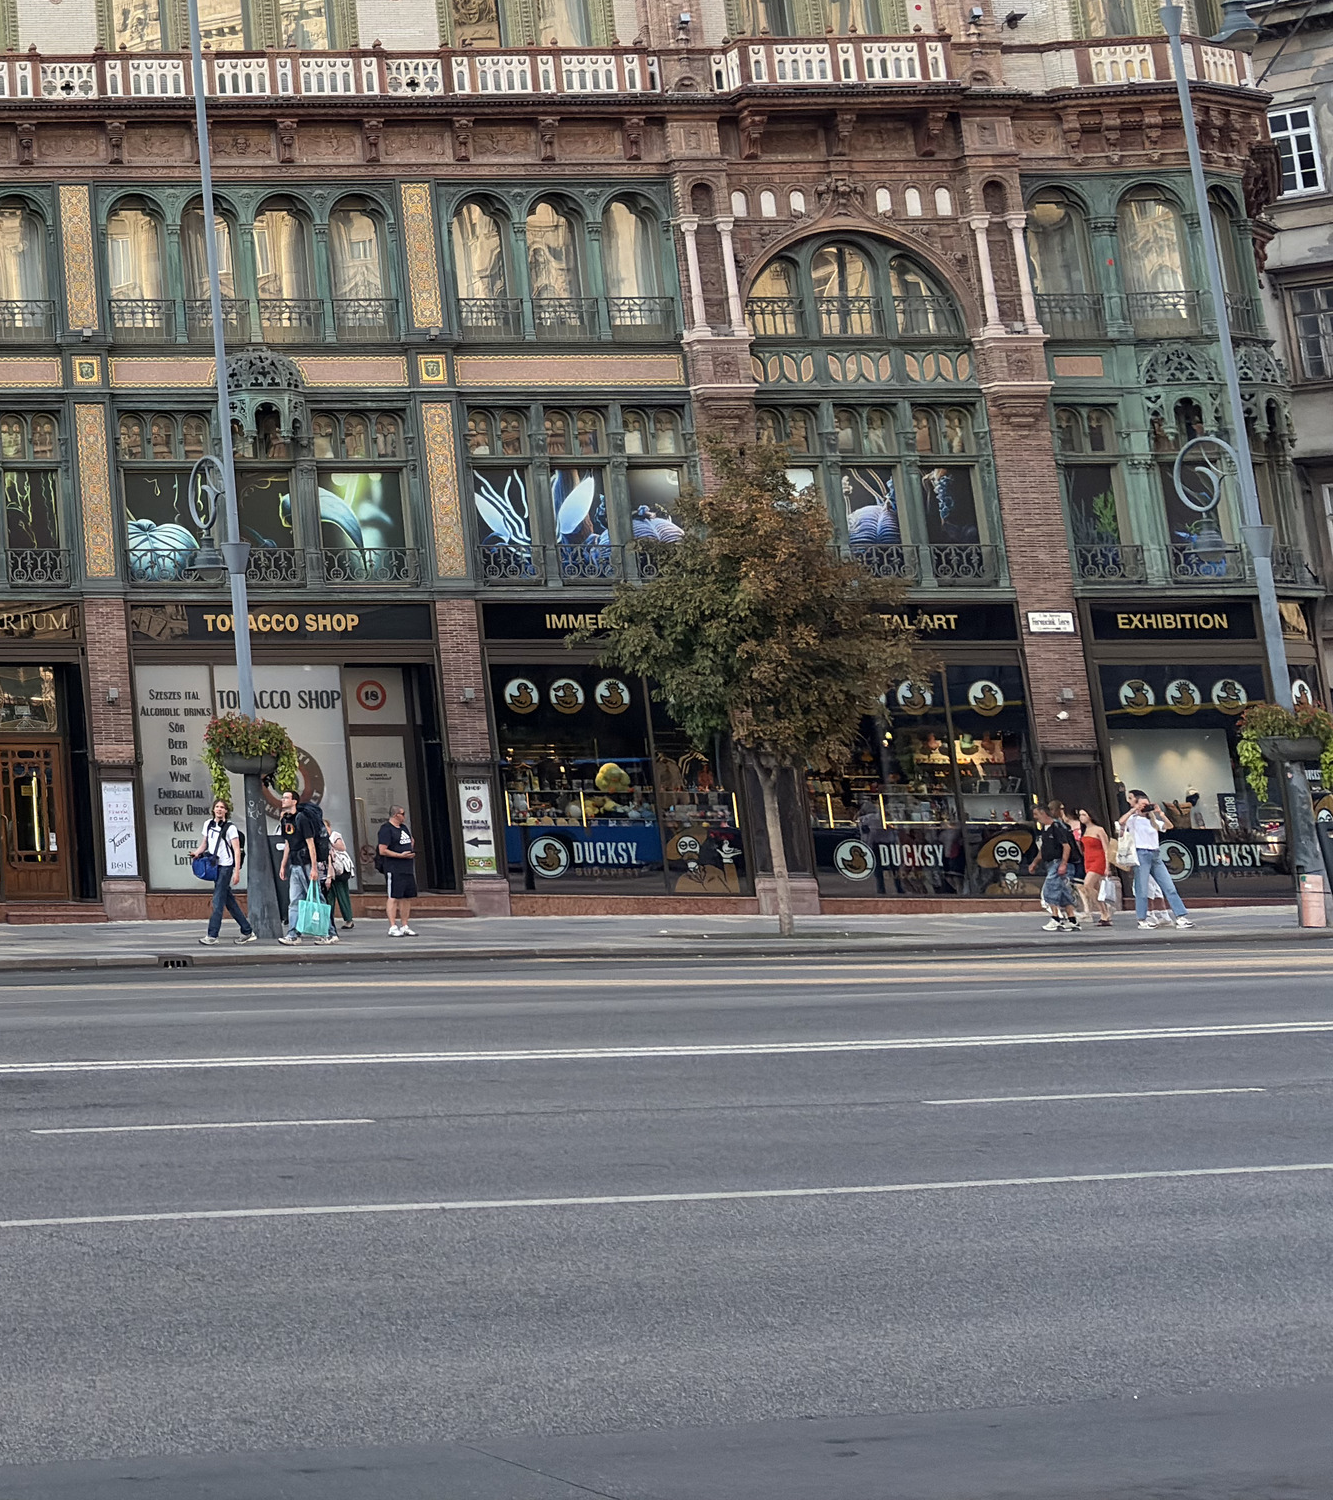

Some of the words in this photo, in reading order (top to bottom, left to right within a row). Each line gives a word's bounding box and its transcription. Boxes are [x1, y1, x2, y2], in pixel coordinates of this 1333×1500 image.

[203, 613, 299, 632] TOACCO
[304, 613, 360, 632] SHOP
[1116, 613, 1228, 629] EXHIBITION
[216, 690, 291, 710] TOACCO
[297, 690, 341, 710] SHOP
[363, 690, 379, 701] 18
[174, 854, 192, 866] LOTT
[572, 841, 637, 864] DUCKSY
[878, 844, 944, 867] DUCKSY
[1195, 844, 1261, 866] DUCKSY
[111, 861, 133, 870] BOIS
